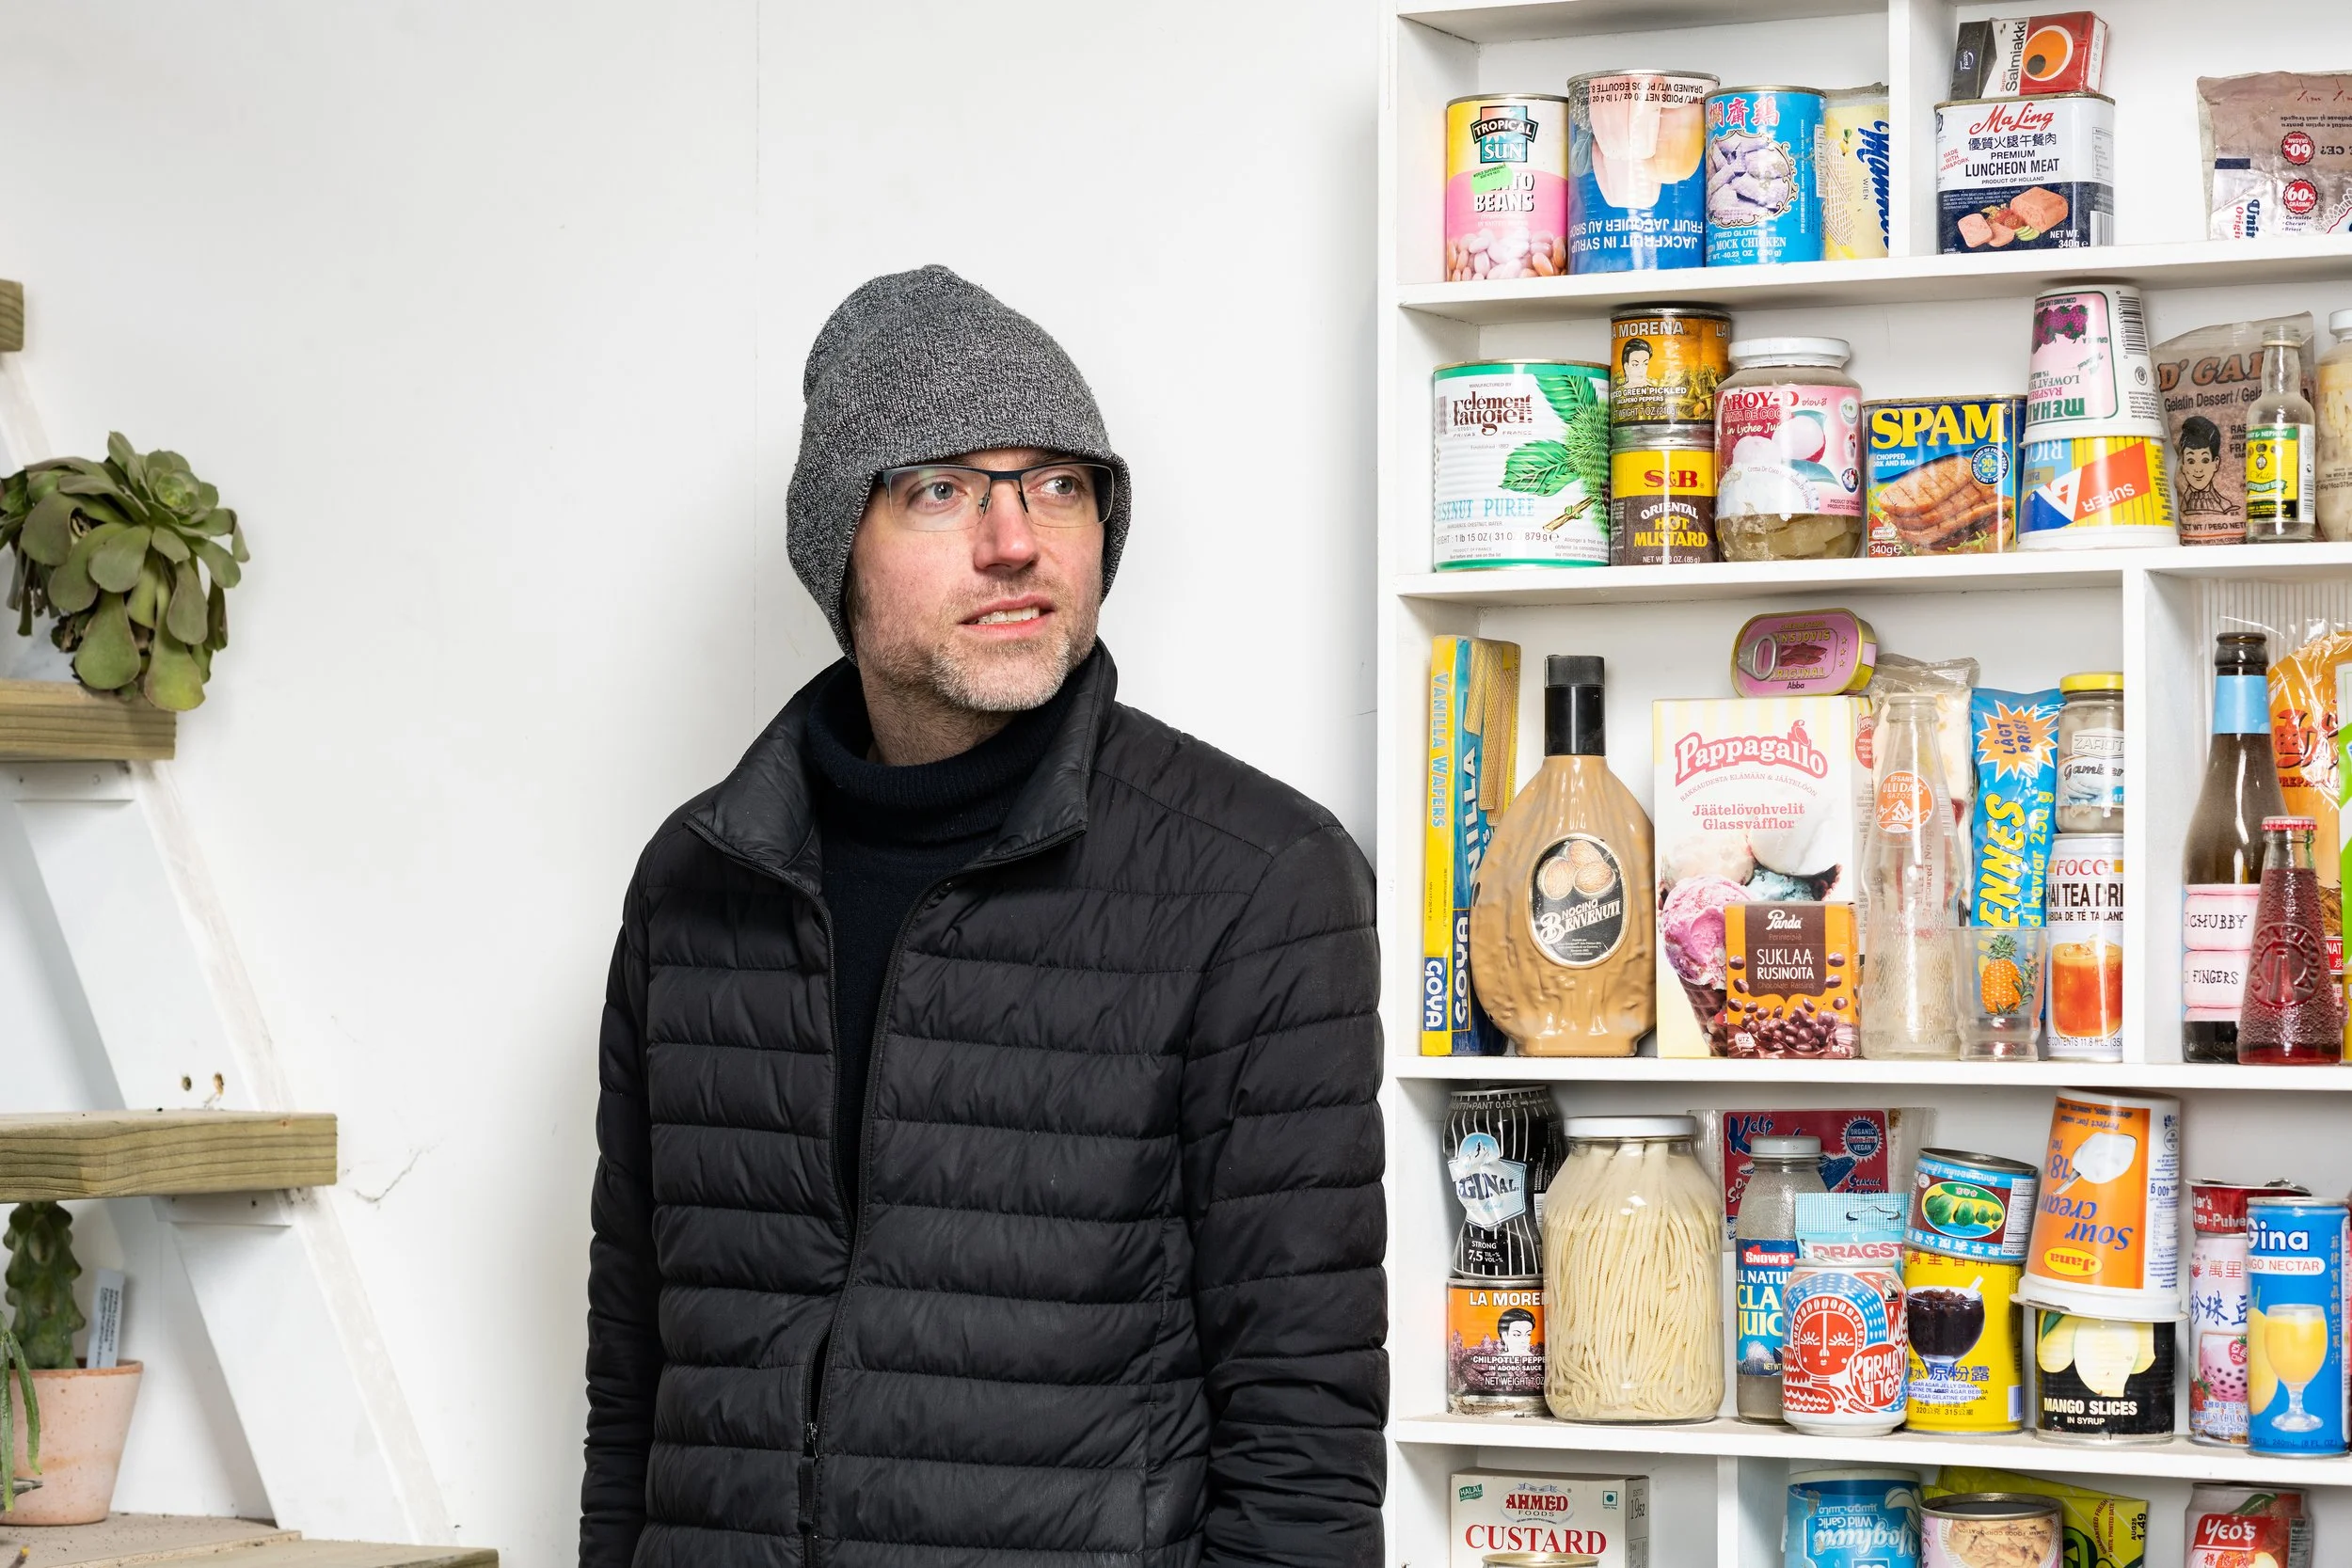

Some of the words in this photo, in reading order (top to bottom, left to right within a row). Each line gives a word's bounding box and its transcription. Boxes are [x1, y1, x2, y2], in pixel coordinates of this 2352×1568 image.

[1960, 50, 1973, 71] Fazer
[2006, 21, 2026, 91] Salmiakki
[1674, 83, 1703, 92] DRAINED
[1645, 93, 1660, 102] NET
[1662, 94, 1683, 103] POIDS
[1474, 120, 1533, 136] TROPICAL
[1484, 143, 1523, 160] SUN
[1944, 149, 1958, 158] MADE
[1991, 150, 2035, 160] PREMIUM
[2285, 144, 2312, 158] 60%
[2320, 145, 2345, 155] CE?
[1946, 154, 1959, 164] WITH
[1965, 161, 2026, 177] LUNCHEON
[2031, 158, 2060, 173] MEAT
[2287, 189, 2314, 202] 60%
[1474, 194, 1534, 213] BEANS
[1589, 220, 1603, 233] AU
[1605, 217, 1670, 233] JACQUIER
[1672, 218, 1704, 233] FRUIT
[1603, 236, 1616, 248] IN
[1620, 234, 1698, 250] JACKFRUIT
[2050, 230, 2064, 239] NET
[2066, 230, 2079, 238] WT.
[1571, 236, 1600, 254] SYRUP
[1716, 239, 1738, 250] MOCK
[1741, 237, 1787, 249] CHICKEN
[2058, 239, 2079, 248] 340g
[1619, 321, 1685, 338] MORENA
[1716, 324, 1726, 337] LA
[2038, 373, 2080, 388] LOWFAT
[1623, 388, 1647, 396] GREEN
[1649, 387, 1688, 395] PICKLED
[1722, 390, 1800, 412] AROY-D
[2164, 394, 2194, 413] Gelatin
[2195, 389, 2233, 407] Dessert
[1619, 407, 1638, 418] WEIGHT
[1645, 407, 1656, 416] OZ
[1724, 410, 1744, 423] NATA
[1745, 409, 1758, 420] DE
[1737, 423, 1763, 436] Lychee
[1871, 403, 2009, 450] SPAM
[2261, 430, 2288, 438] NEPHEW
[1885, 459, 1899, 467] AND
[1645, 470, 1698, 488] S&B
[2081, 483, 2136, 514] SUPER
[1641, 501, 1699, 519] ORIENTAL
[1654, 515, 1690, 531] HOT
[2208, 522, 2228, 531] PESO
[1525, 532, 1541, 541] 879
[1634, 531, 1709, 547] MUSTARD
[1870, 545, 1893, 556] 340g
[1431, 673, 1448, 754] VANILLA
[1994, 722, 2017, 755] LÅGT
[2012, 719, 2035, 754] PRIS!
[1677, 732, 1826, 784] Pappagallo
[1430, 756, 1448, 828] WAFERS
[1679, 773, 1728, 802] RAKKAUDESTA
[1729, 771, 1766, 781] ELÄMÄÄN
[1774, 774, 1819, 798] JÄÄTELÖÖN
[1692, 802, 1805, 816] Jäätelövohvelit
[2030, 808, 2048, 845] 250
[2056, 858, 2108, 877] FOCO
[2028, 850, 2044, 911] kaviar
[2062, 883, 2091, 908] TEA
[1562, 898, 1598, 920] NOCINO
[2065, 911, 2074, 921] DE
[2076, 909, 2087, 921] TÉ
[1540, 900, 1621, 944] BENVENUTI
[1766, 909, 1803, 930] Panda
[2189, 914, 2248, 929] CHUBBY
[1769, 932, 1802, 942] Perinteisiä
[1456, 915, 1470, 1025] GOYA
[1757, 966, 1815, 980] RUSINOITA
[2193, 970, 2240, 985] FINGERS
[1790, 981, 1815, 990] Raisins
[1424, 958, 1446, 1031] GOYA
[2051, 1037, 2078, 1047] CONTENTS
[2080, 1037, 2093, 1047] 11.8
[1496, 1101, 1512, 1110] 0,15
[1850, 1128, 1875, 1136] ORGANIC
[2091, 1119, 2120, 1131] Perfect
[1728, 1115, 1774, 1156] Kelp
[1848, 1135, 1877, 1144] Gluten-Free
[1848, 1173, 1882, 1188] Seaweed
[2157, 1185, 2170, 1197] 400
[2064, 1222, 2134, 1252] Sour
[2247, 1216, 2310, 1251] Gina
[1471, 1241, 1497, 1250] STRONG
[1468, 1250, 1484, 1262] 7,5
[1745, 1252, 1789, 1264] SNOW'S
[2050, 1252, 2096, 1272] Jana
[2268, 1259, 2320, 1272] NECTAR
[1470, 1291, 1488, 1307] LA
[1472, 1355, 1520, 1364] CHILPOTLE
[1850, 1350, 1901, 1384] KARMA
[1485, 1376, 1501, 1386] NET
[1501, 1376, 1530, 1386] WEIGHT
[2043, 1398, 2085, 1415] MANGO
[2089, 1400, 2137, 1416] SLICES
[2076, 1417, 2106, 1425] SYRUP
[1459, 1484, 1482, 1497] HALAL
[1505, 1494, 1568, 1512] AHMED
[1629, 1499, 1645, 1520] 1952
[2094, 1498, 2108, 1517] FRESH
[1818, 1516, 1845, 1528] Garlic
[1847, 1515, 1872, 1528] Wild
[2137, 1513, 2147, 1541] 1.49
[1465, 1524, 1607, 1555] CUSTARD
[2093, 1516, 2107, 1555] GUARANTEED
